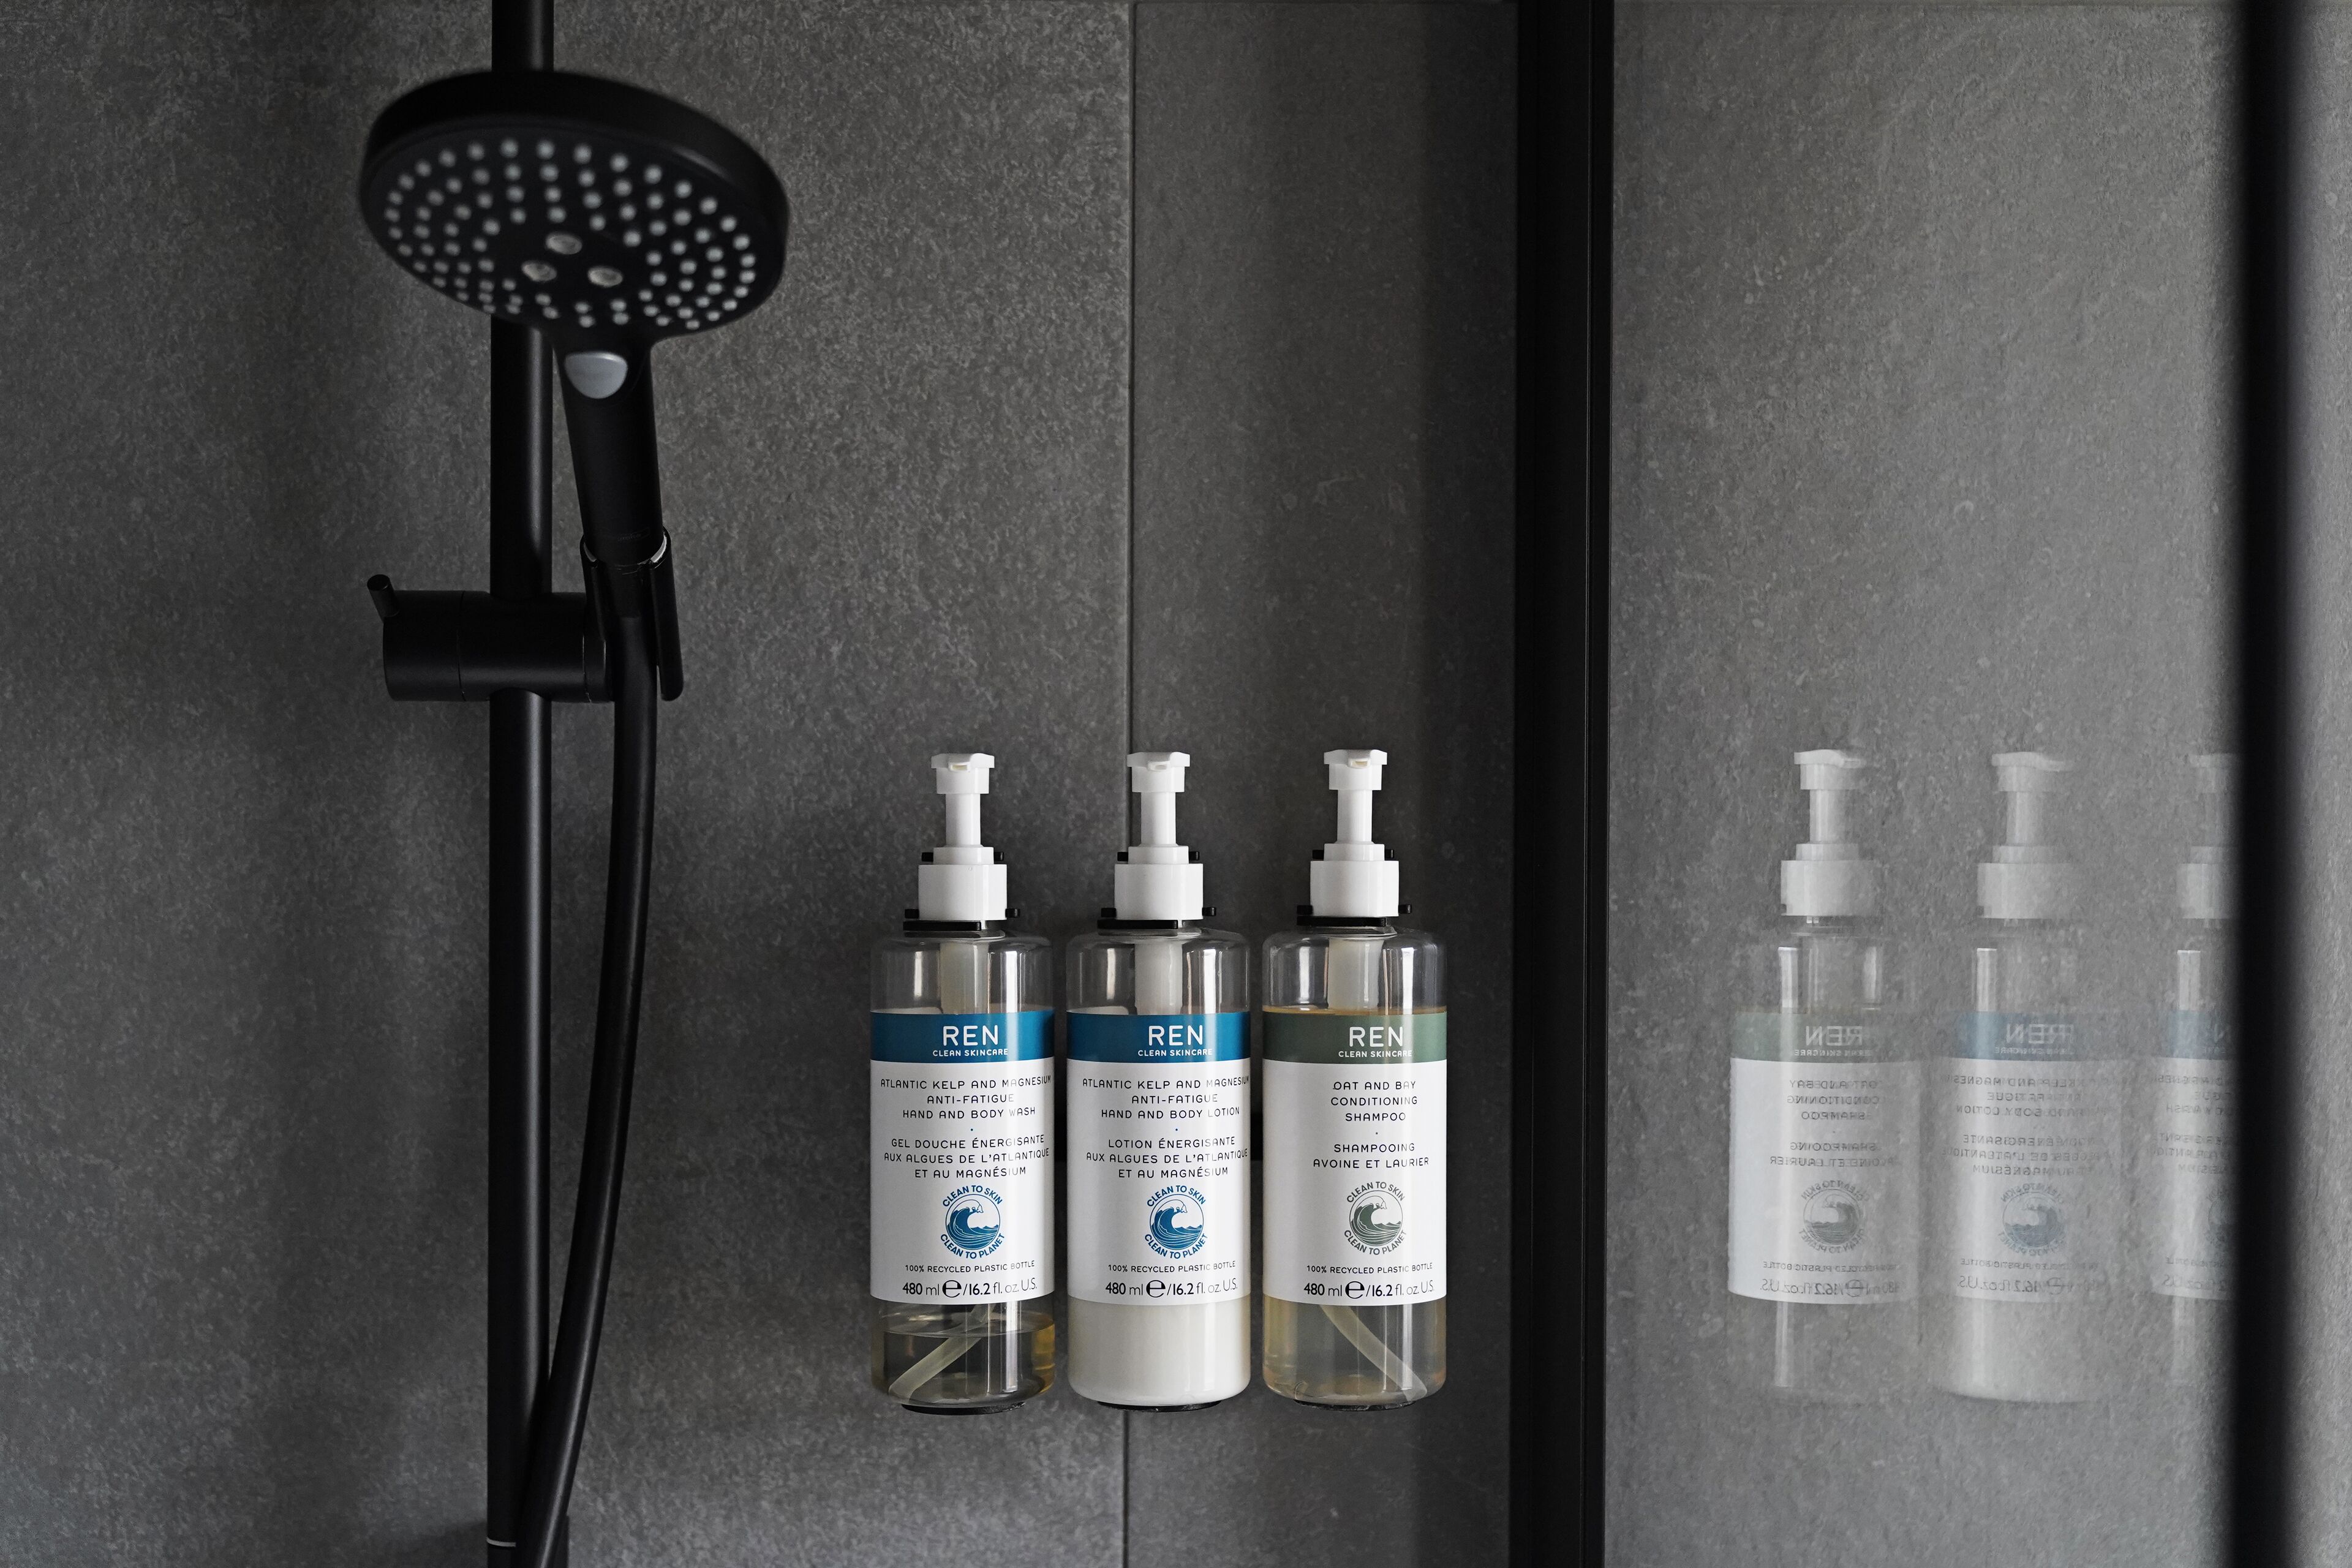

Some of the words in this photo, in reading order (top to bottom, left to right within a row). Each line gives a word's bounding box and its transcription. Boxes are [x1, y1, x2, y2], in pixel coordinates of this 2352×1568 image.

[943, 1025, 998, 1046] REN
[1148, 1025, 1202, 1046] REN
[1349, 1027, 1403, 1047] REN
[881, 1079, 927, 1089] ATLANTIC
[971, 1080, 996, 1088] AND
[1002, 1075, 1051, 1087] MAGNESIUM
[1083, 1079, 1131, 1089] ATLANTIC
[1176, 1080, 1200, 1088] AND
[1333, 1082, 1359, 1090] OAT
[1396, 1081, 1415, 1090] BAY
[927, 1094, 1014, 1104] ANTI-FATIGUE
[1132, 1094, 1218, 1104] ANTI-FATIGUE
[1331, 1096, 1417, 1106] CONDITIONING
[903, 1110, 933, 1118] HAND
[971, 1109, 1004, 1118] BODY
[1009, 1107, 1035, 1117] WASH
[1101, 1109, 1132, 1118] HAND
[1170, 1110, 1202, 1118] BODY
[1208, 1107, 1240, 1117] LOTION
[1346, 1112, 1406, 1121] SHAMPOO
[892, 1139, 910, 1148] GEL
[915, 1140, 965, 1148] DOUCHE
[972, 1134, 1044, 1148] ÉNERGISANTE
[1109, 1139, 1152, 1148] LOTION
[1159, 1136, 1235, 1148] ÉNERGISANTE
[1334, 1144, 1414, 1153] SHAMPOOING
[884, 1152, 902, 1162] AUX
[906, 1155, 953, 1163] ALGUES
[960, 1155, 975, 1163] DE
[1087, 1152, 1104, 1161] AUX
[1110, 1154, 1158, 1163] ALGUES
[1164, 1155, 1180, 1163] DE
[1313, 1159, 1359, 1168] AVOINE
[1366, 1159, 1380, 1168] ET
[1386, 1157, 1429, 1168] LAURIER
[915, 1169, 928, 1178] ET
[933, 1170, 950, 1178] AU
[956, 1166, 1026, 1178] MAGNÉSIUM
[1118, 1169, 1132, 1178] ET
[1161, 1167, 1228, 1178] MAGNÉSIUM
[943, 1186, 969, 1207] CLEAN
[984, 1188, 1002, 1204] SKIN
[1147, 1186, 1174, 1207] CLEAN
[1188, 1188, 1206, 1204] SKIN
[1347, 1182, 1373, 1203] CLEAN
[1388, 1184, 1405, 1201] SKIN
[940, 1234, 963, 1257] CLEAN
[979, 1233, 1005, 1258] PLANET
[1145, 1234, 1167, 1257] CLEAN
[1183, 1233, 1208, 1258] PLANET
[1344, 1230, 1367, 1253] CLEAN
[1382, 1230, 1406, 1254] PLANET
[1011, 1261, 1035, 1270] BOTTLE
[1213, 1261, 1235, 1269] BOTTLE
[1412, 1262, 1432, 1271] BOTTLE
[902, 1283, 922, 1295] 480
[925, 1284, 939, 1295] ml
[1106, 1282, 1126, 1295] 480
[1129, 1284, 1143, 1295] ml
[1304, 1283, 1325, 1295] 480
[1328, 1284, 1342, 1296] ml
